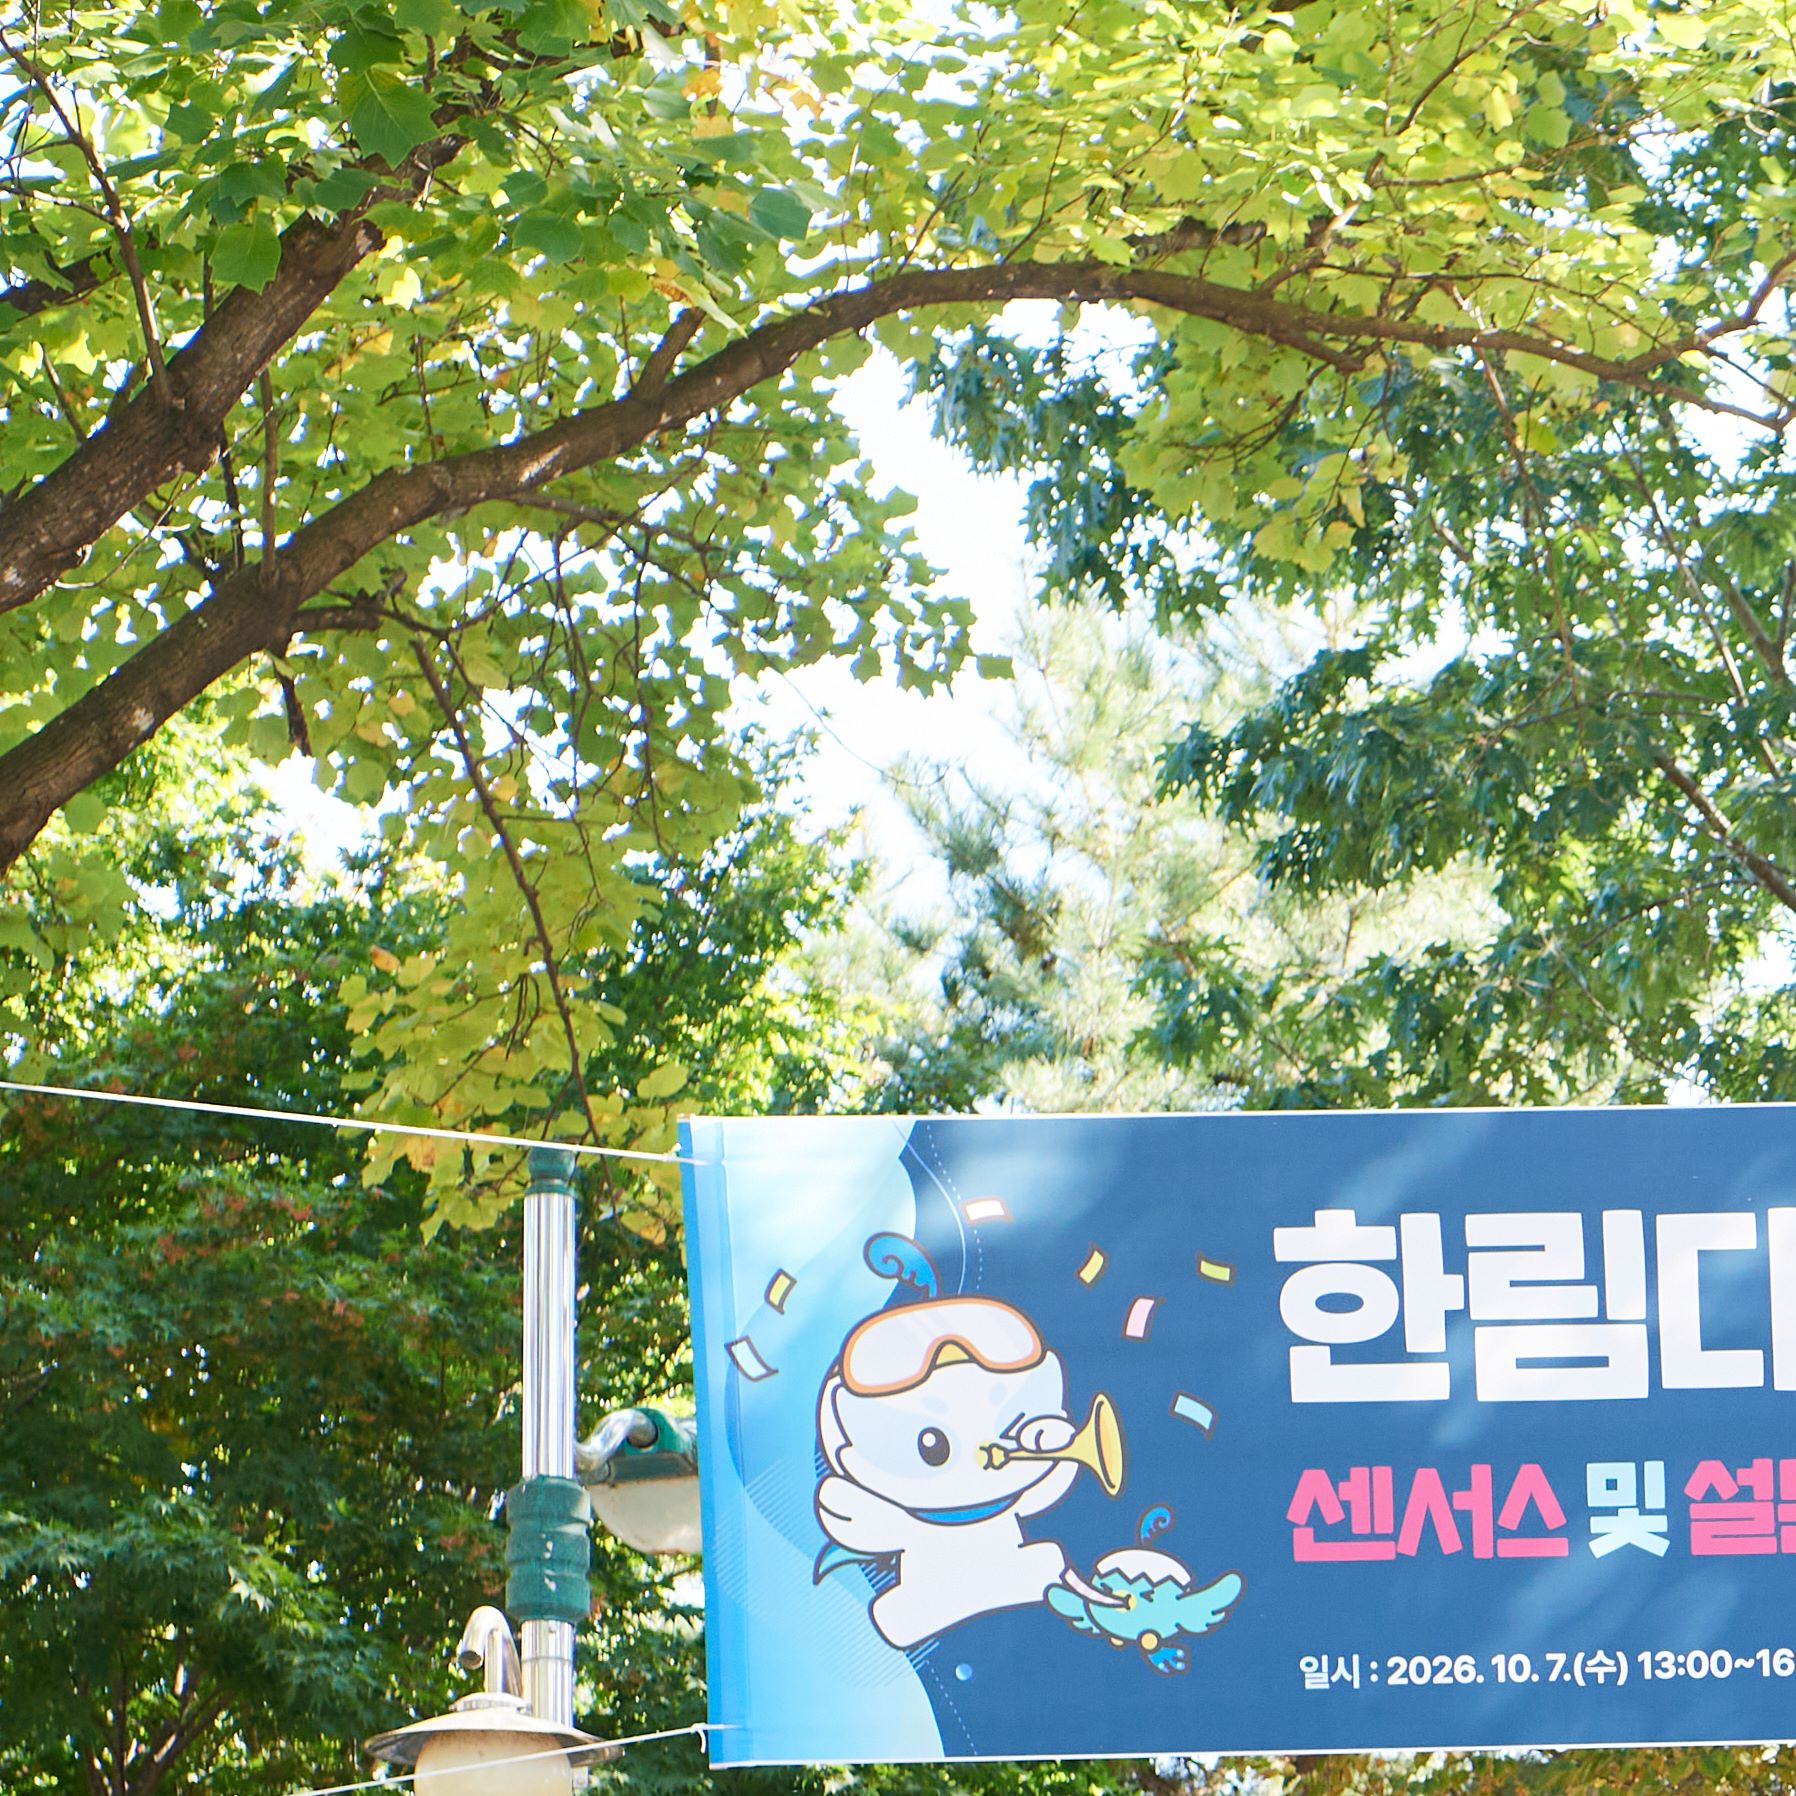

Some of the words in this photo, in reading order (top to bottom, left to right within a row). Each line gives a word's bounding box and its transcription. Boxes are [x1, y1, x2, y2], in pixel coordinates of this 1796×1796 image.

[1287, 1457, 1569, 1563] 센서스
[1587, 1459, 1670, 1555] 및
[1298, 1656, 1361, 1688] 일시
[1387, 1656, 1483, 1684] 2026.
[1491, 1655, 1539, 1683] 10.
[1546, 1651, 1629, 1687] 7.(수)
